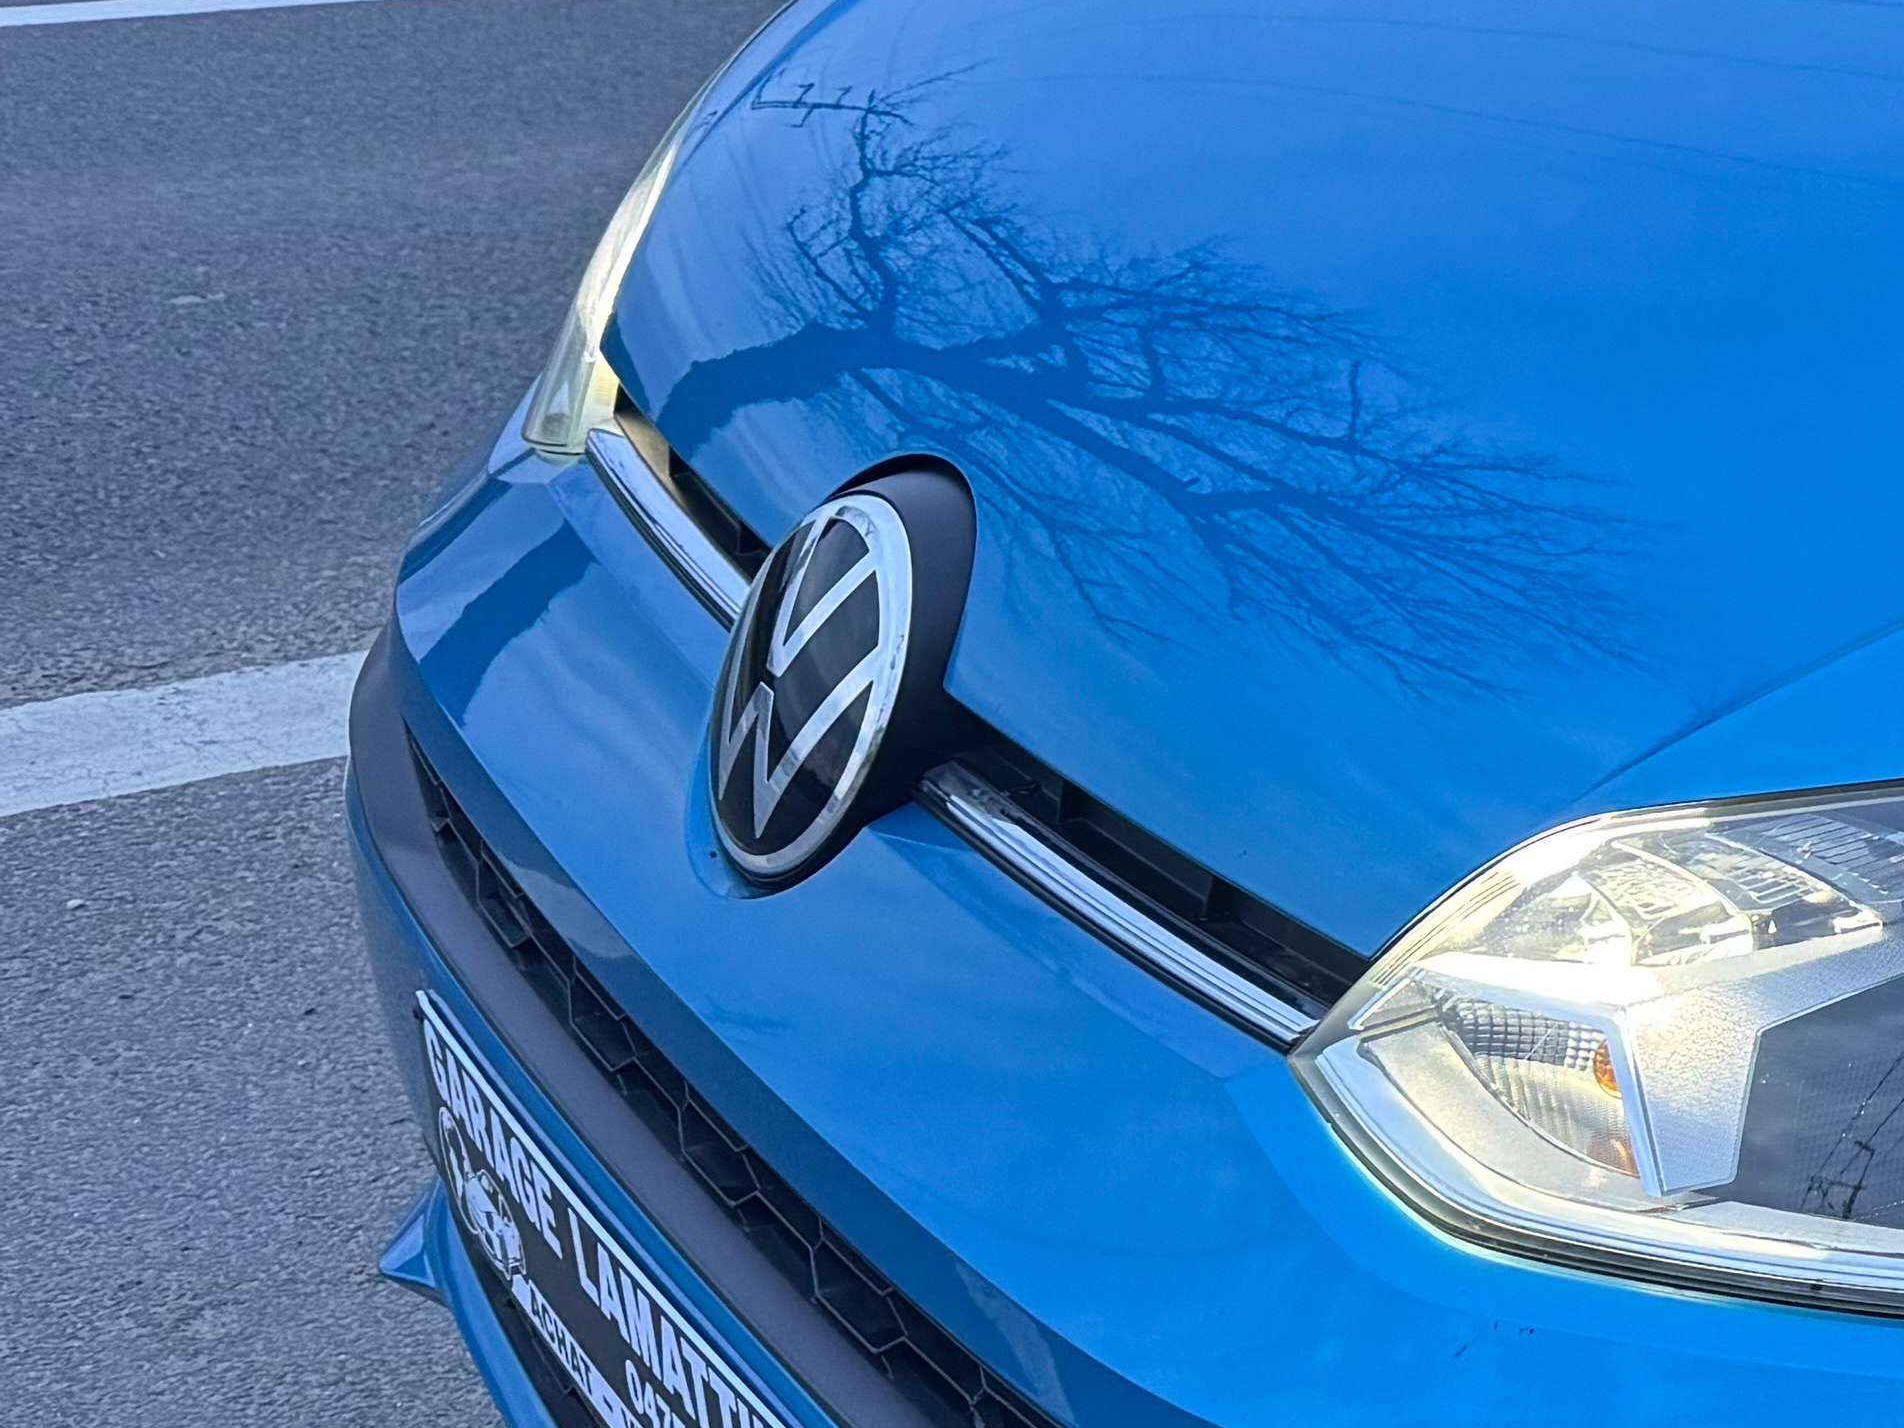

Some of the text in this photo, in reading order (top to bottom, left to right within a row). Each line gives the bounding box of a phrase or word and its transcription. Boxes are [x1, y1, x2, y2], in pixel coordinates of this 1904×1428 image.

[708, 493, 913, 873] VW
[423, 1018, 563, 1260] GARAGE
[528, 1281, 593, 1396] ACHAT
